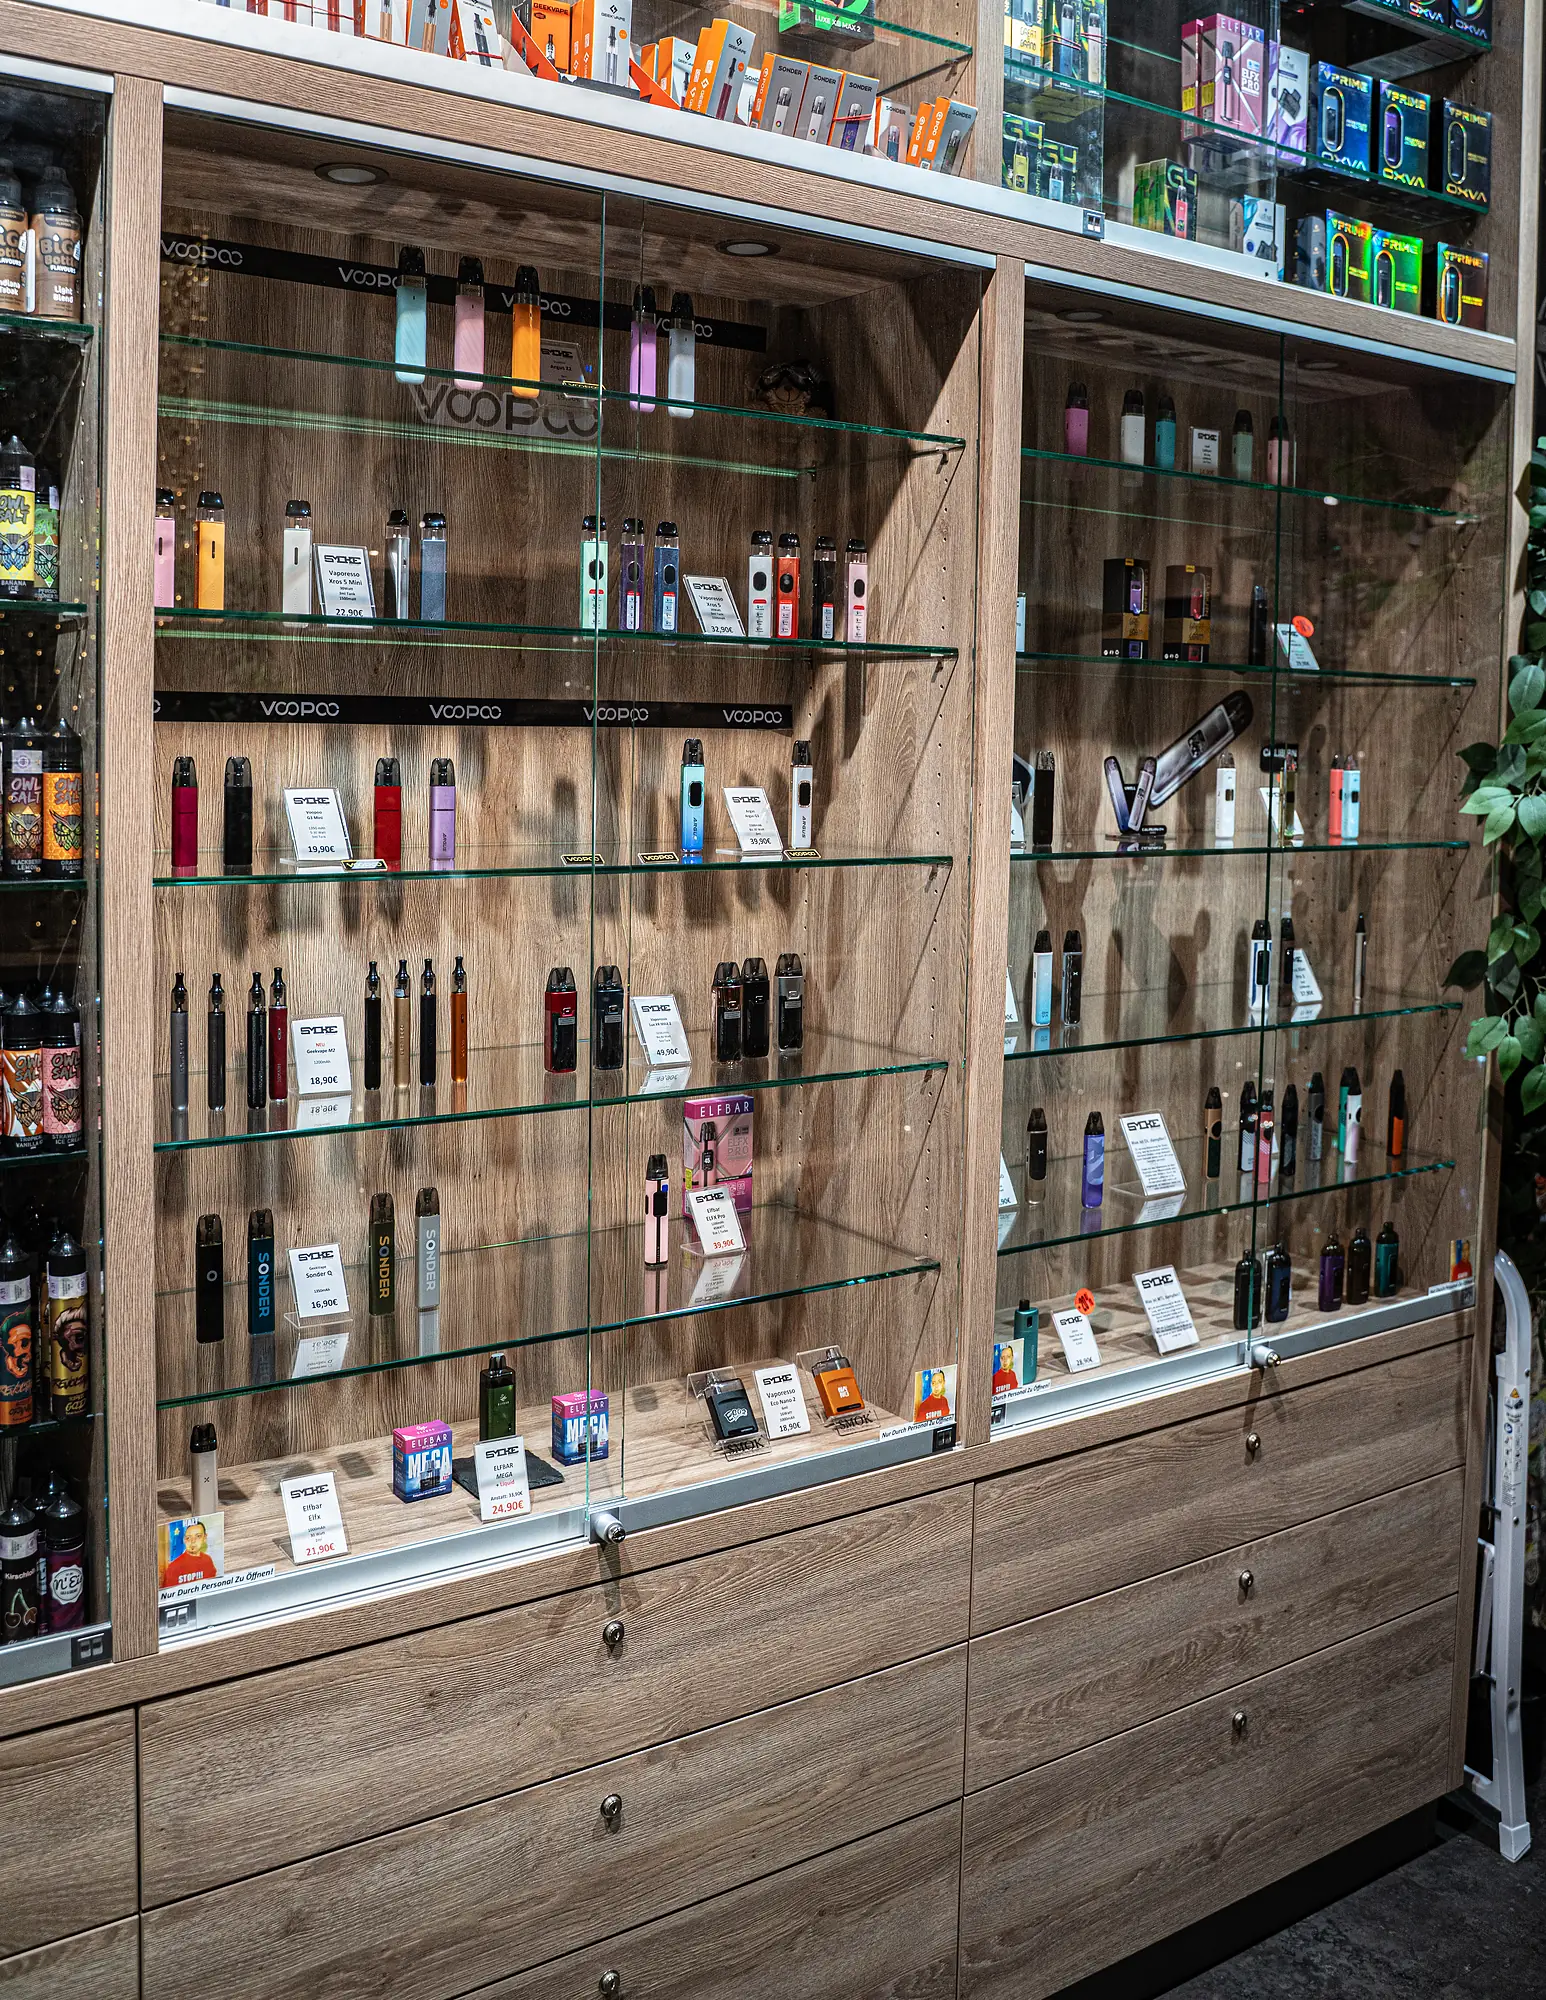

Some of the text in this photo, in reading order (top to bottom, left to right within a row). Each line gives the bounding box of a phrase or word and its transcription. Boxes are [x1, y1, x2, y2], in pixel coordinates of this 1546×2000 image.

[533, 2, 569, 16] GEEKVAPE
[1409, 2, 1444, 23] OXVA
[815, 14, 831, 25] LUXE
[842, 20, 856, 31] MAX
[1221, 18, 1261, 40] ELFBAR
[1455, 19, 1488, 39] OXVA
[778, 65, 803, 76] SONDER
[1241, 68, 1260, 81] ELFX
[744, 75, 760, 83] SOND
[813, 74, 837, 85] SONDER
[1241, 79, 1260, 90] PRO
[849, 82, 873, 93] SONDER
[885, 105, 906, 115] SONDER
[952, 109, 972, 120] SONDER
[1167, 167, 1198, 192] G4
[1382, 167, 1425, 189] OXVA
[1446, 183, 1488, 203] OXVA
[160, 238, 243, 266] VOOPOO
[44, 254, 76, 268] Bottl
[49, 264, 77, 275] FLAVOURS
[54, 285, 73, 296] Light
[53, 293, 74, 304] Blend
[501, 291, 571, 317] VPOO
[0, 494, 30, 511] OWL
[0, 508, 30, 525] SALT
[328, 570, 360, 578] Vaporesso
[335, 608, 364, 618] 22,90€
[711, 625, 734, 634] 32,90€
[260, 700, 340, 717] VOOPOO
[429, 704, 504, 721] VOOPOO
[583, 706, 649, 723] VOOPOO
[723, 709, 783, 724] VOOPOO
[11, 776, 42, 792] OWL
[10, 790, 42, 805] SALT
[750, 838, 772, 846] 39,90€
[308, 845, 336, 854] 19,90€
[643, 854, 676, 862] VOOPOO
[656, 1047, 680, 1057] 49,90€
[310, 1075, 338, 1086] 18,90€
[700, 1101, 750, 1118] ELFBAR
[727, 1147, 748, 1156] PRO
[712, 1239, 735, 1250] 39,90€
[379, 1235, 390, 1299] SONDER
[425, 1229, 436, 1292] SONDER
[257, 1252, 271, 1318] SONDER
[311, 1298, 339, 1310] 16,90€
[766, 1388, 796, 1399] Vaporesso
[993, 1394, 1007, 1402] Durch
[1007, 1387, 1027, 1398] Personal
[779, 1421, 801, 1432] 18,90€
[836, 1412, 873, 1430] SMOK
[882, 1431, 892, 1439] Nur
[891, 1427, 907, 1436] Durch
[907, 1421, 929, 1432] Personal
[411, 1433, 448, 1449] ELFBAR
[725, 1437, 766, 1454] SMOK
[407, 1446, 452, 1482] MEGA
[493, 1462, 514, 1472] ELFBAR
[495, 1471, 513, 1480] MEGA
[302, 1503, 323, 1513] Elfbar
[491, 1500, 524, 1515] 24.90€
[308, 1513, 321, 1522] Elfx
[305, 1542, 335, 1557] 21,90€
[4, 1567, 36, 1581] Kirschlol
[160, 1568, 274, 1600] Nur Durch Personal Zu Öffnen!
